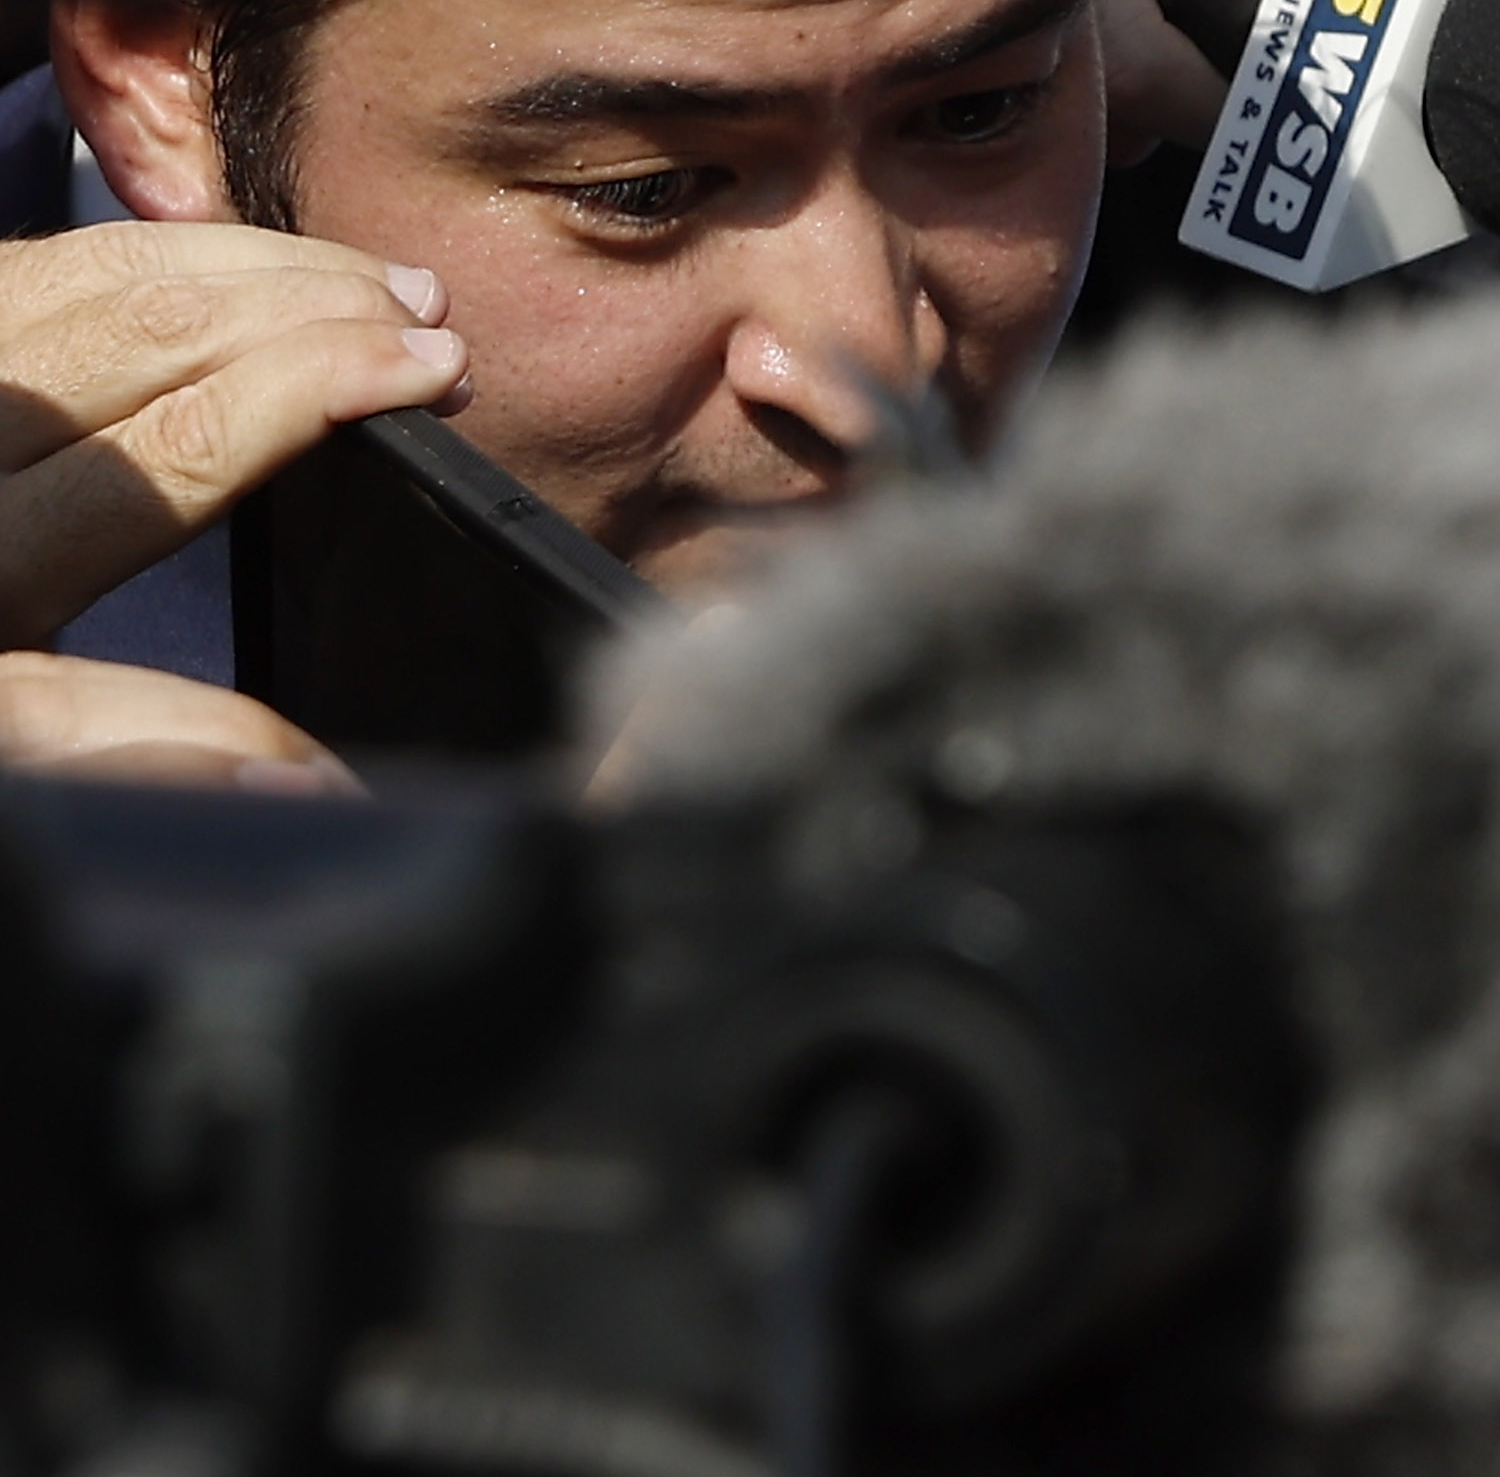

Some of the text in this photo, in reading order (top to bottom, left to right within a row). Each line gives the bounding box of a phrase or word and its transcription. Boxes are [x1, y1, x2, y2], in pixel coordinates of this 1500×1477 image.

[1240, 98, 1262, 121] &
[1254, 31, 1369, 234] WSB
[1203, 138, 1249, 223] TALK
